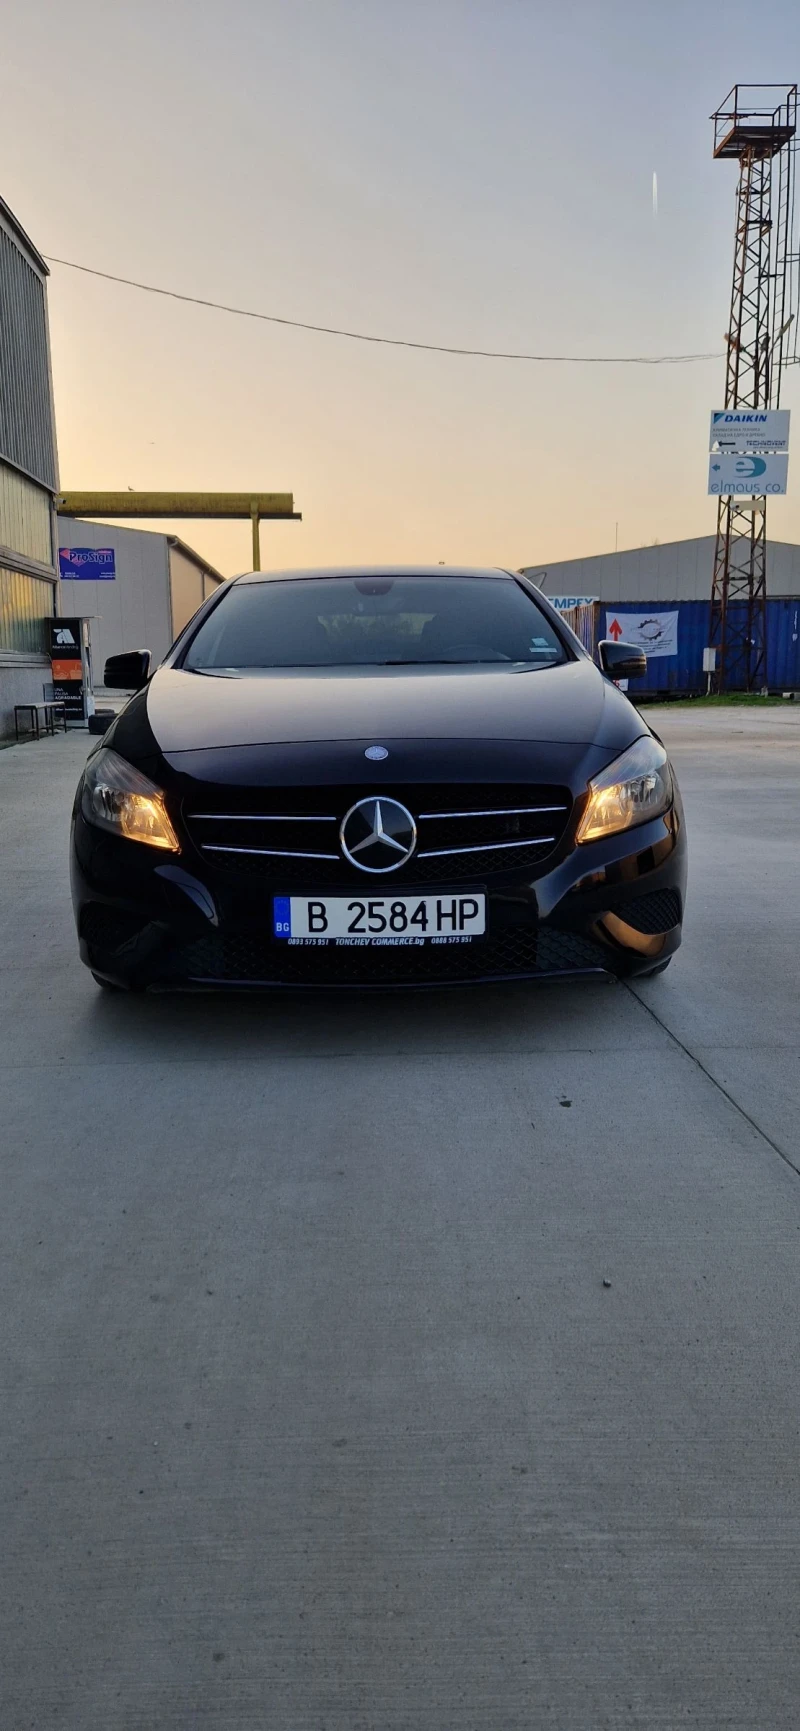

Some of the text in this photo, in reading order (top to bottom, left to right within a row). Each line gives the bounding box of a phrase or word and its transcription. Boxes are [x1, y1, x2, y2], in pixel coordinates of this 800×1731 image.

[724, 414, 767, 422] DAIKIN
[710, 480, 784, 493] elmaus co.
[69, 550, 113, 564] ProSign
[307, 899, 479, 933] B 2584 HP
[276, 922, 290, 932] BG
[335, 938, 370, 946] TONCHEV
[371, 937, 425, 946] COMMERCE.bg
